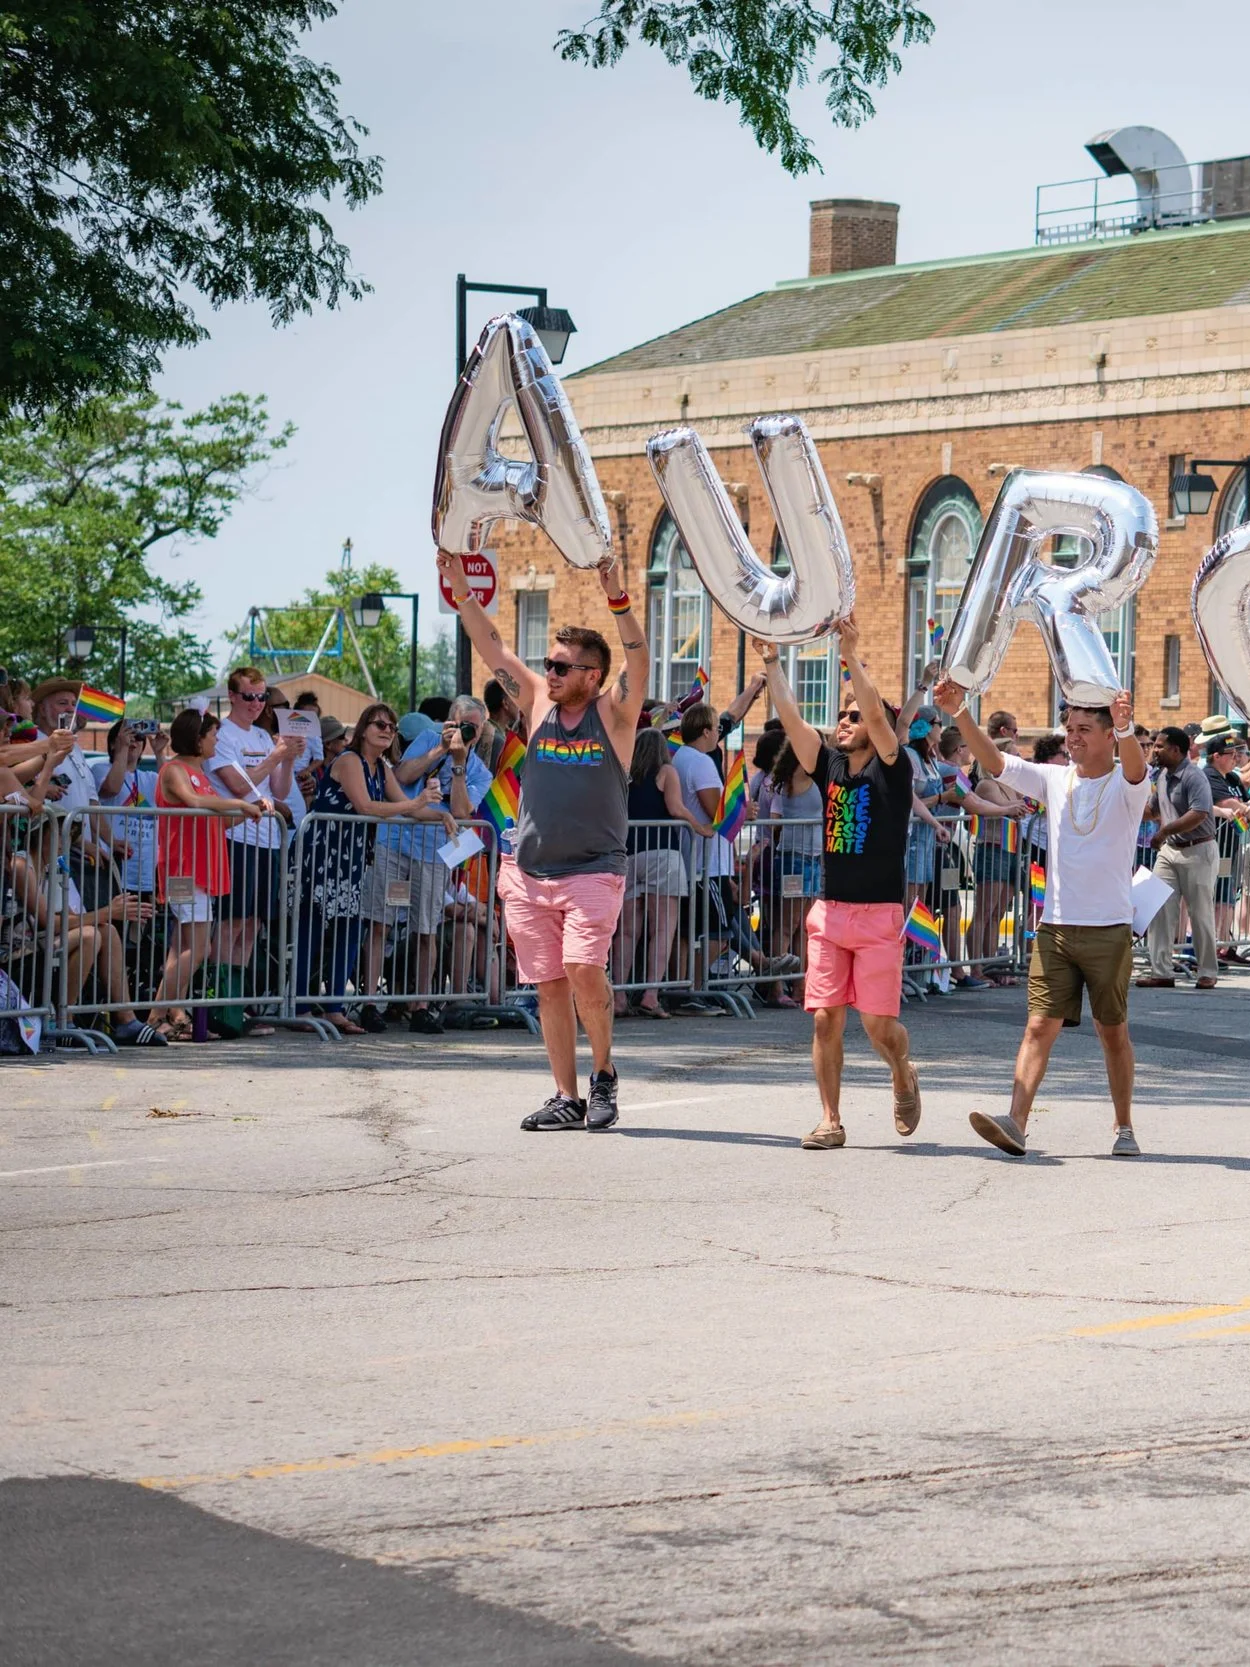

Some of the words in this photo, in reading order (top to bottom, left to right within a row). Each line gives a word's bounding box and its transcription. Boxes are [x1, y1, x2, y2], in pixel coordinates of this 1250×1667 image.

[467, 562, 488, 573] NOT
[543, 738, 604, 763] LOVE
[826, 781, 870, 804] MORE
[825, 820, 868, 839] LESS
[826, 836, 864, 855] HATE
